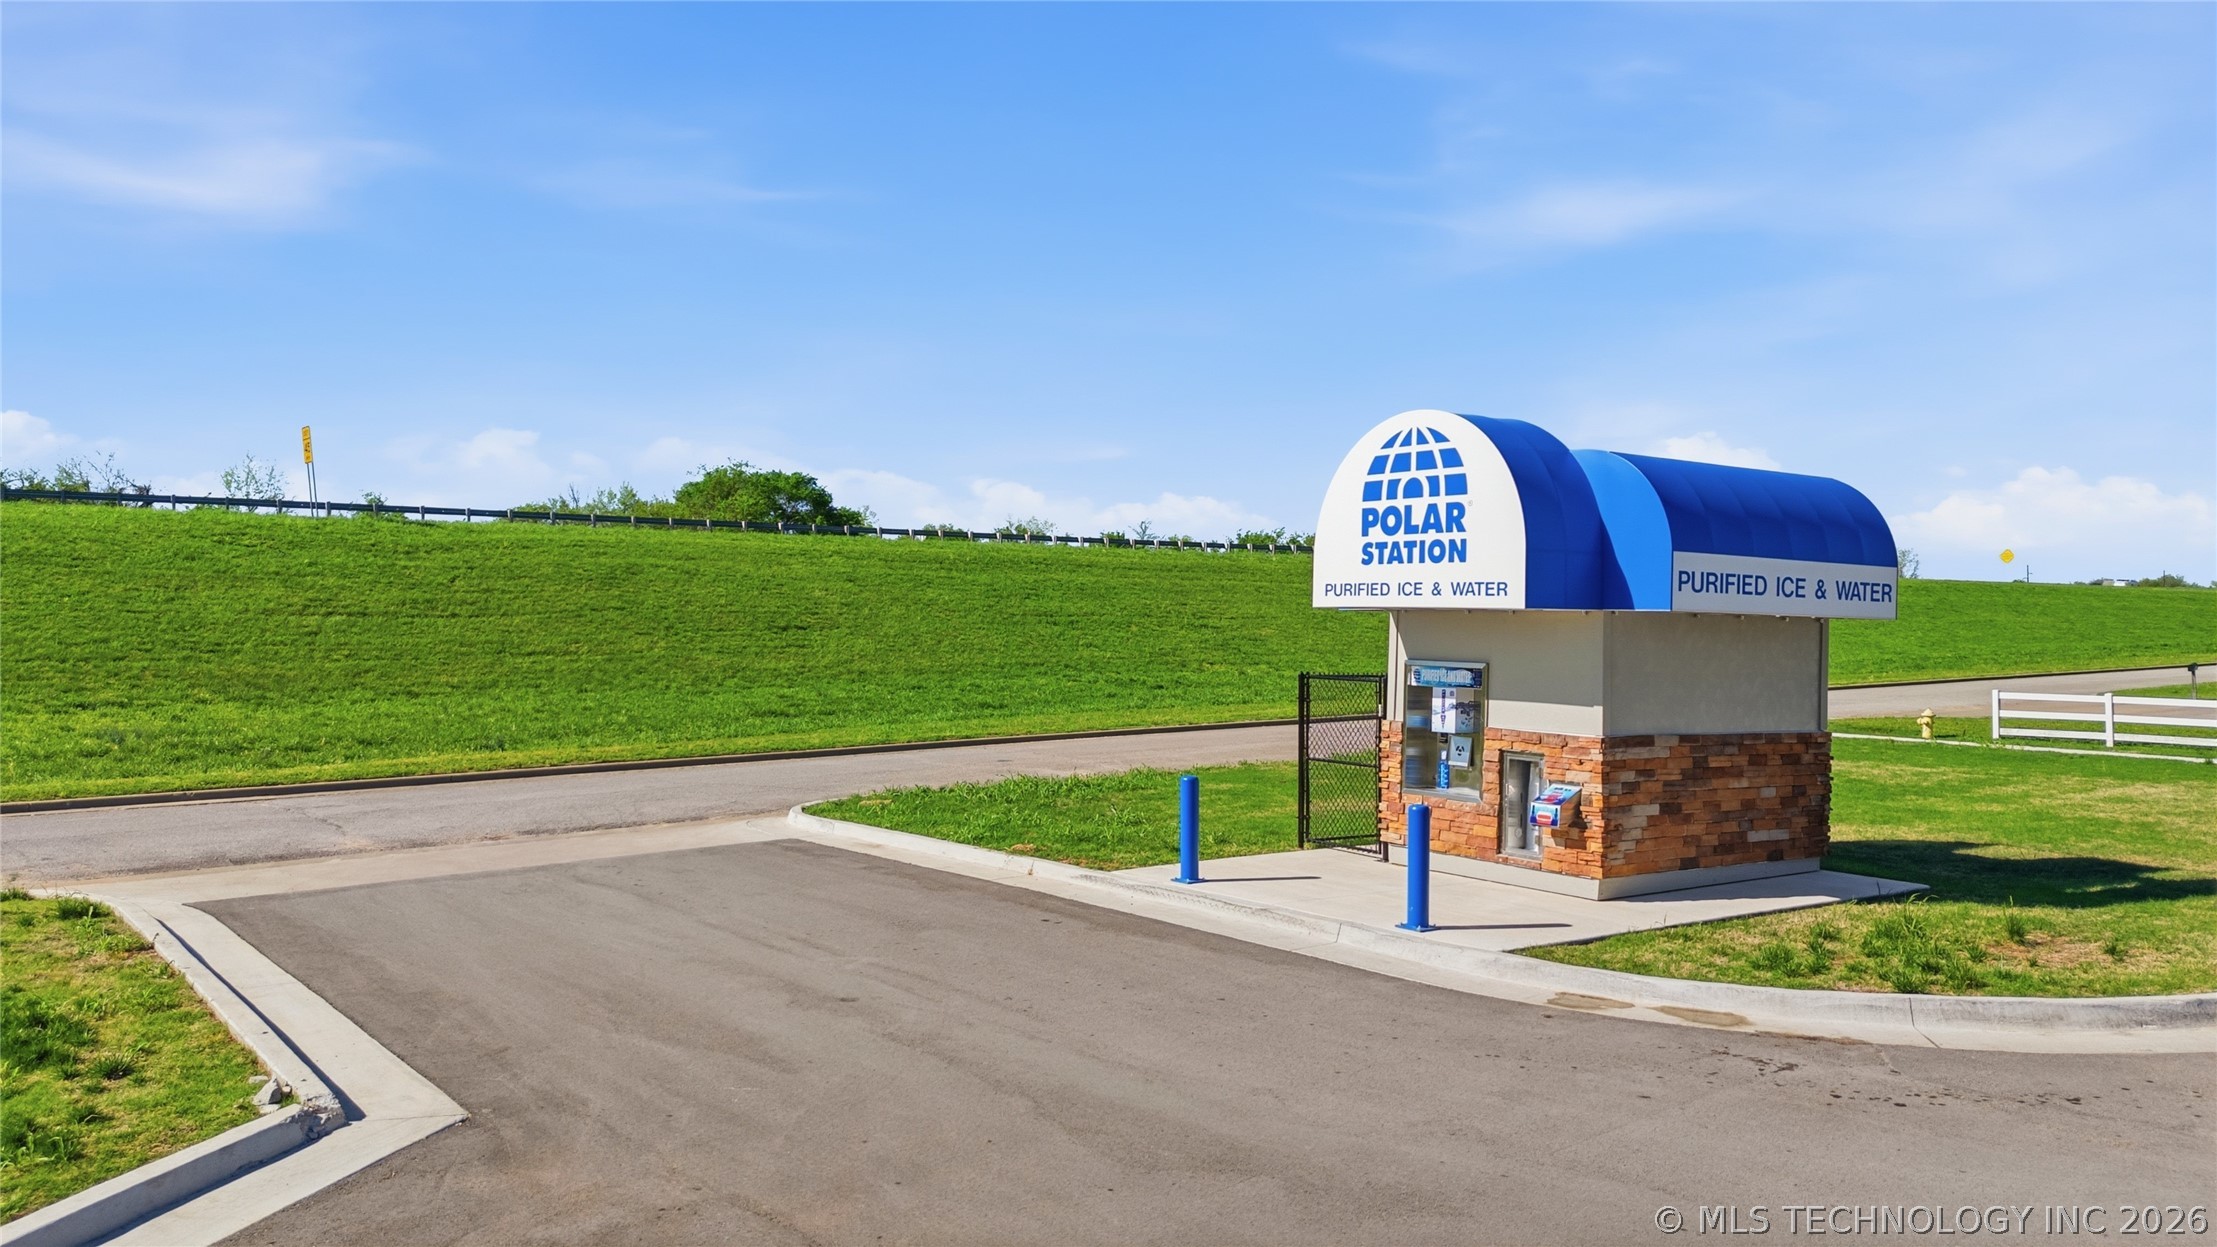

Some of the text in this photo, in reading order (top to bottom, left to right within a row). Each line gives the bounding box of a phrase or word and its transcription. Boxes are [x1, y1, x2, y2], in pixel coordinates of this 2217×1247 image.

[1361, 501, 1466, 537] POLAR
[1361, 538, 1467, 566] STATION
[1324, 581, 1508, 597] PURIFIED ICE & WATER
[1678, 570, 1892, 603] PURIFIED ICE & WATER
